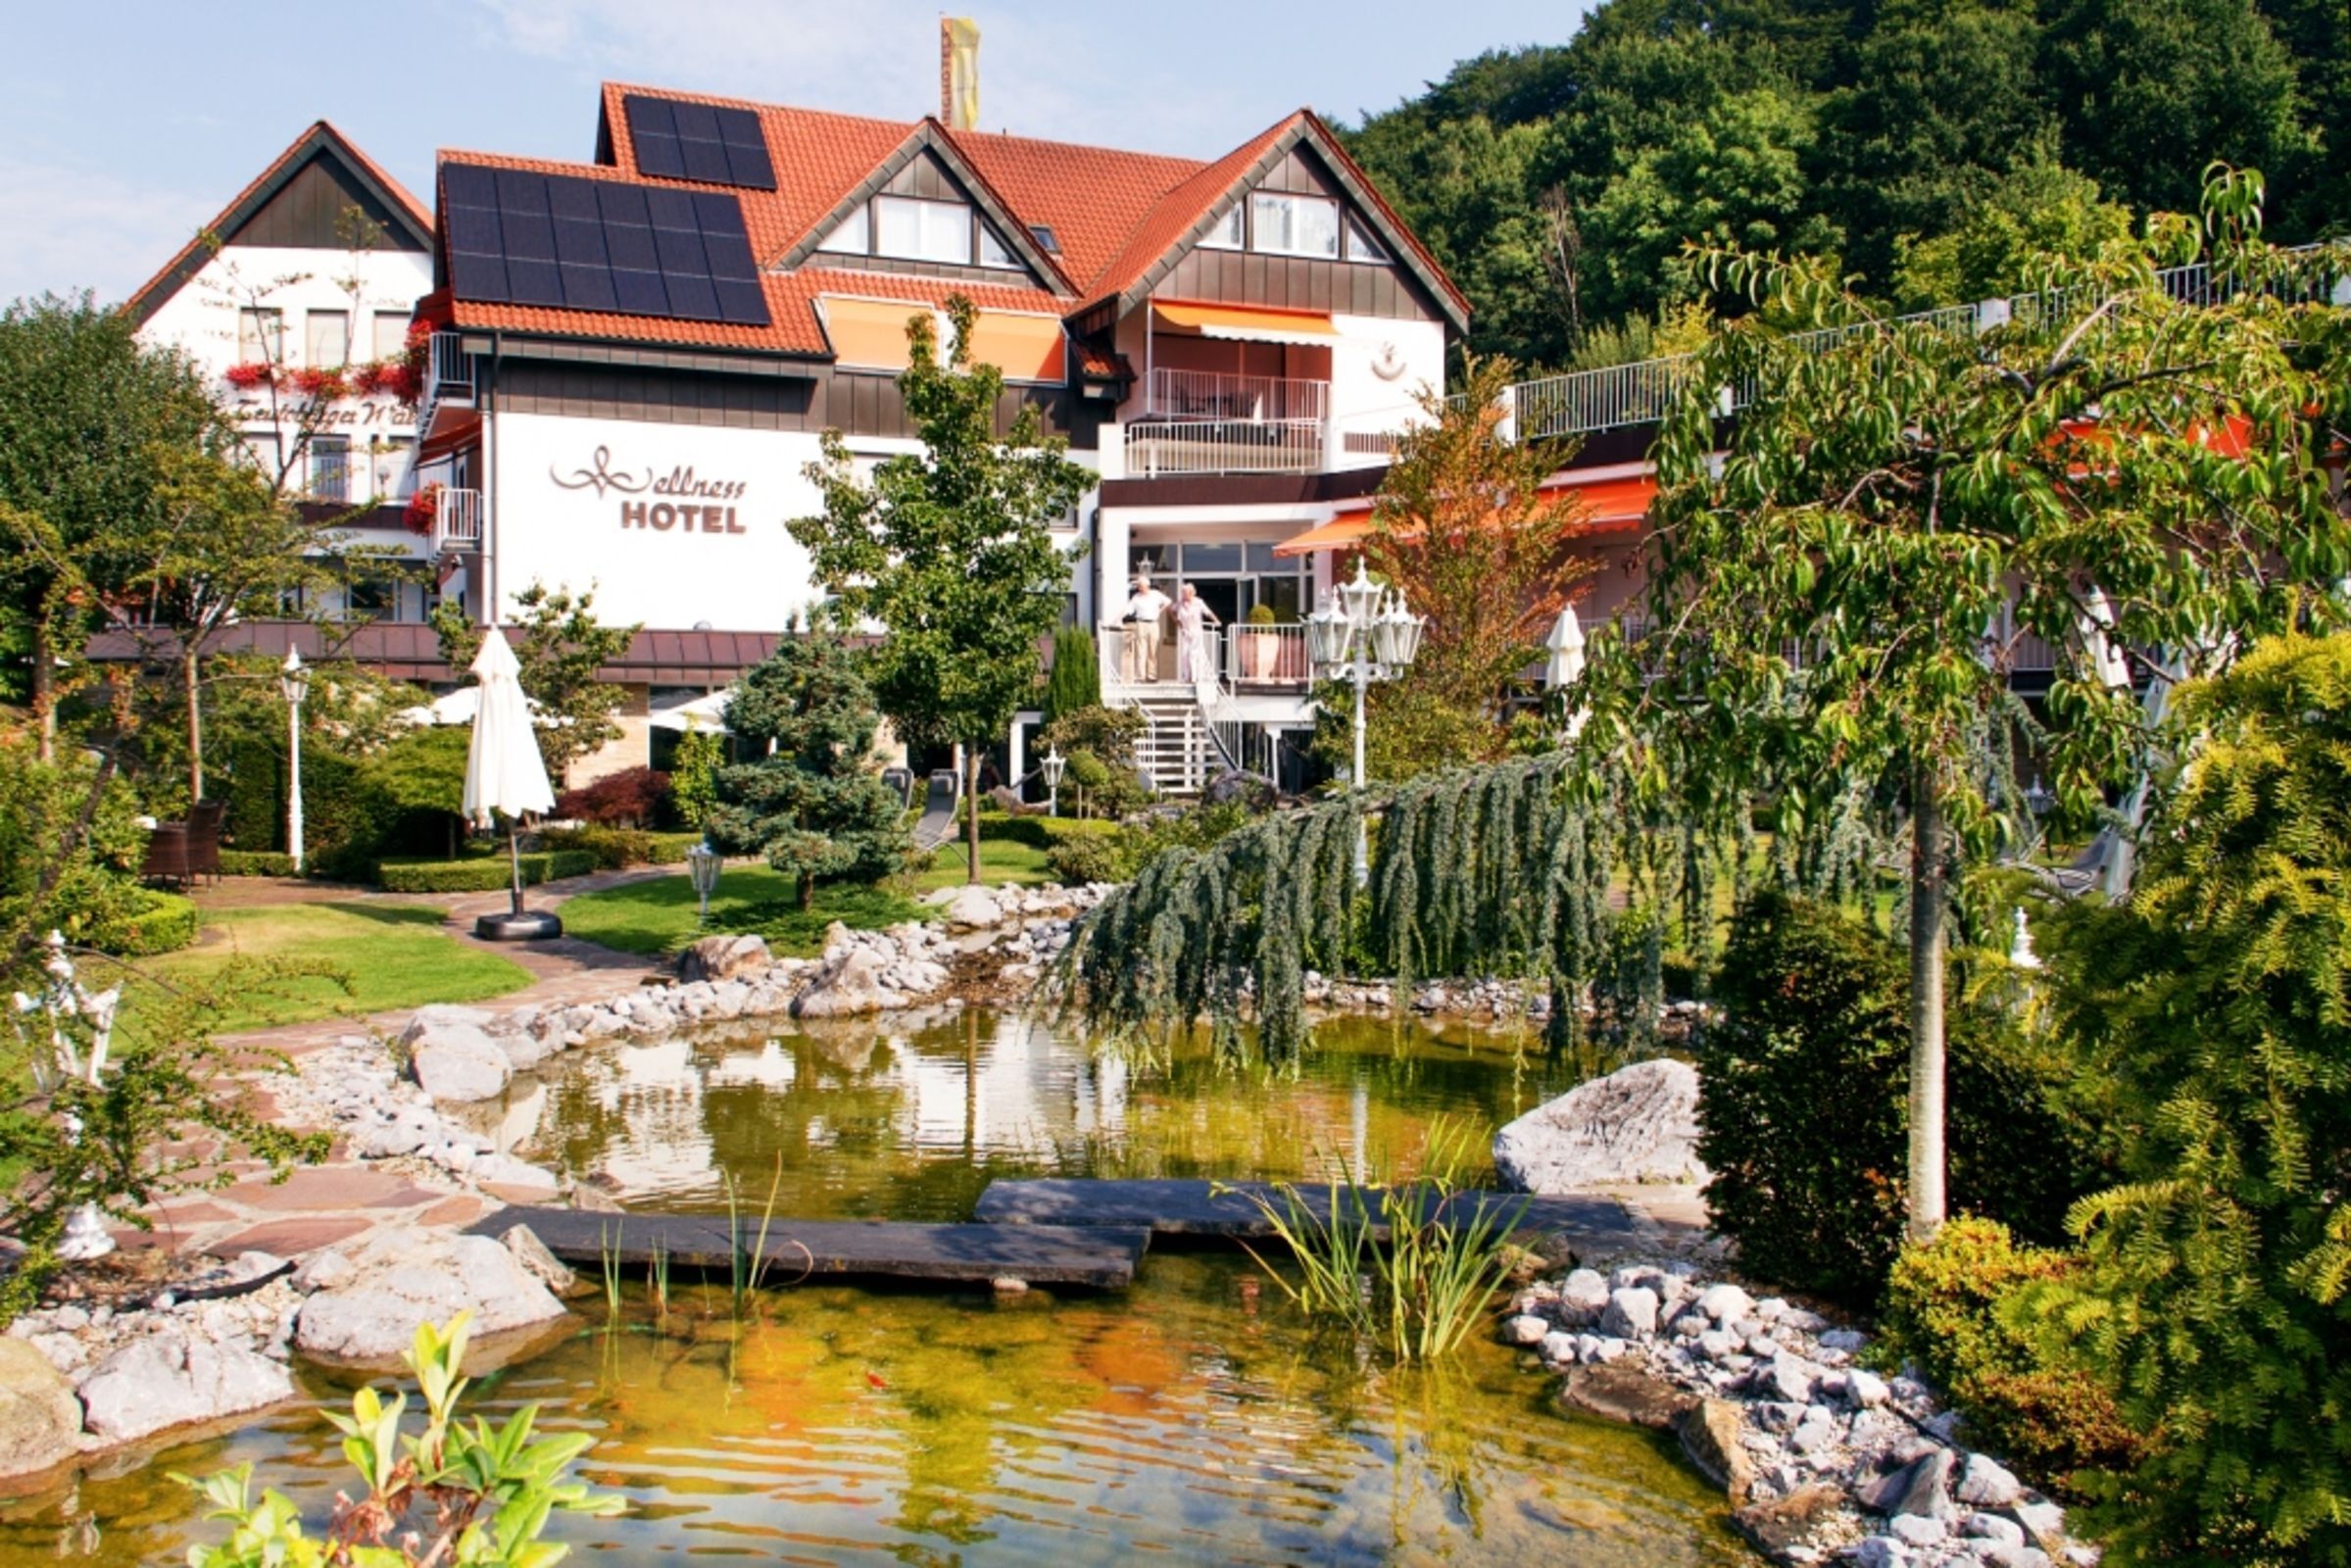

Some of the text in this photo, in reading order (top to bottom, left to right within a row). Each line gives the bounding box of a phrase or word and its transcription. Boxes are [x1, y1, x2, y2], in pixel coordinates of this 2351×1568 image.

[362, 401, 417, 425] Wal
[550, 445, 747, 499] Wellness
[621, 501, 747, 534] HOTEL
